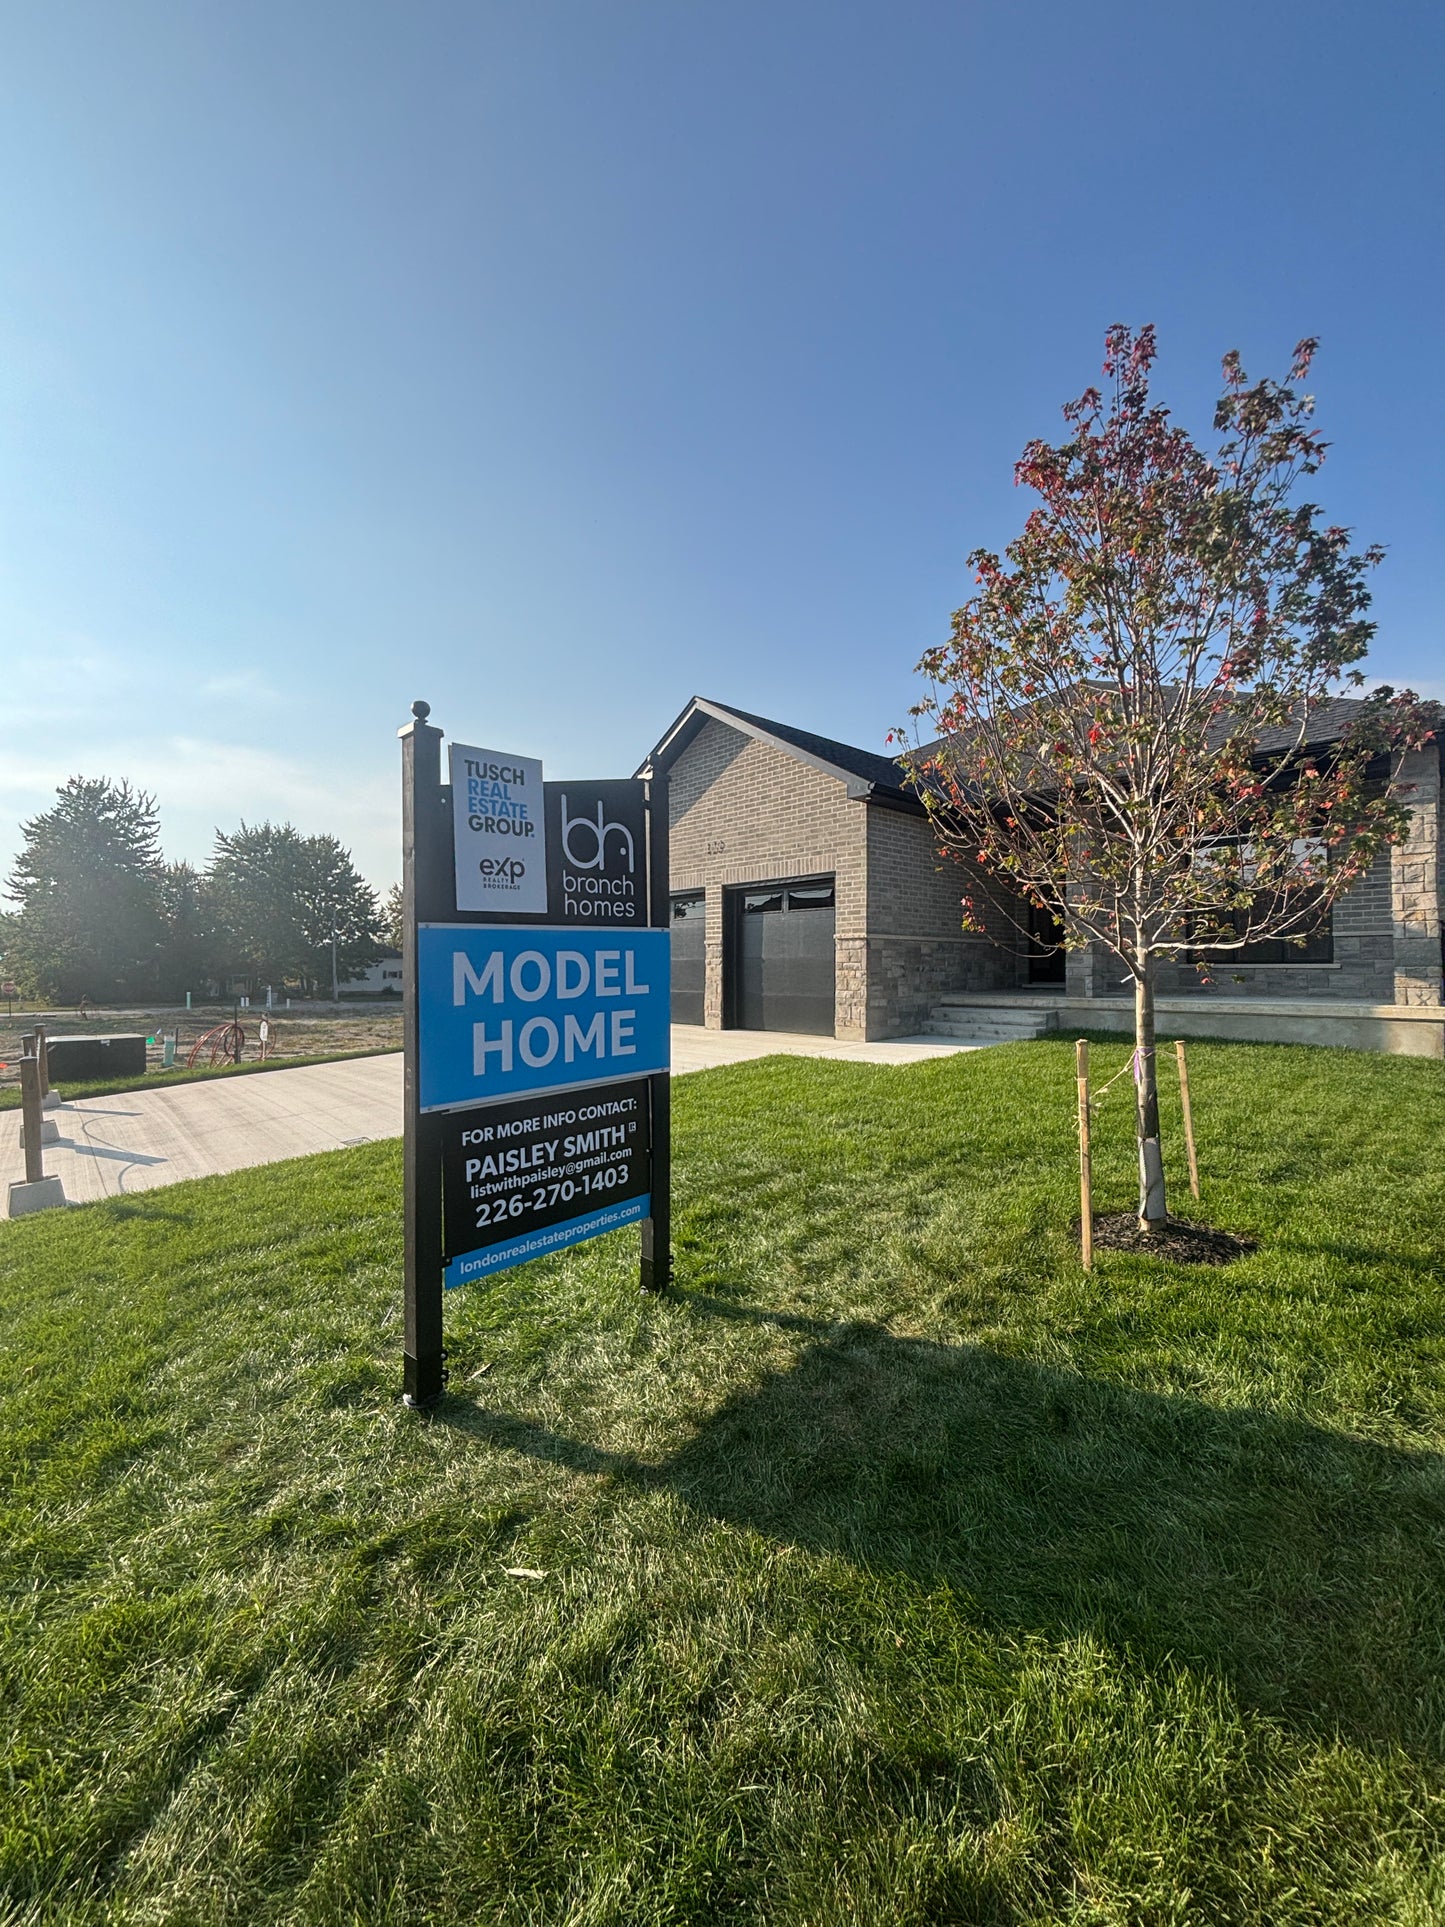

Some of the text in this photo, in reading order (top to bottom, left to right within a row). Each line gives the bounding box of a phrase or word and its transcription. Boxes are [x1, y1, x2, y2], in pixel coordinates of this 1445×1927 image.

[464, 759, 524, 786] TUSCH
[468, 778, 511, 800] REAL
[468, 796, 528, 820] ESTATE
[563, 870, 634, 896] branch
[565, 893, 635, 918] homes
[453, 950, 650, 1007] MODEL
[473, 1009, 636, 1076] HOME
[462, 1098, 638, 1147] FOR MORE INFO CONTACT:
[465, 1124, 626, 1183] PAISLEY SMITH
[470, 1147, 633, 1199] listwithpaisley@gmail.com
[475, 1164, 630, 1228] 226-270-1403
[460, 1203, 641, 1275] londonrealestateproperties.com
